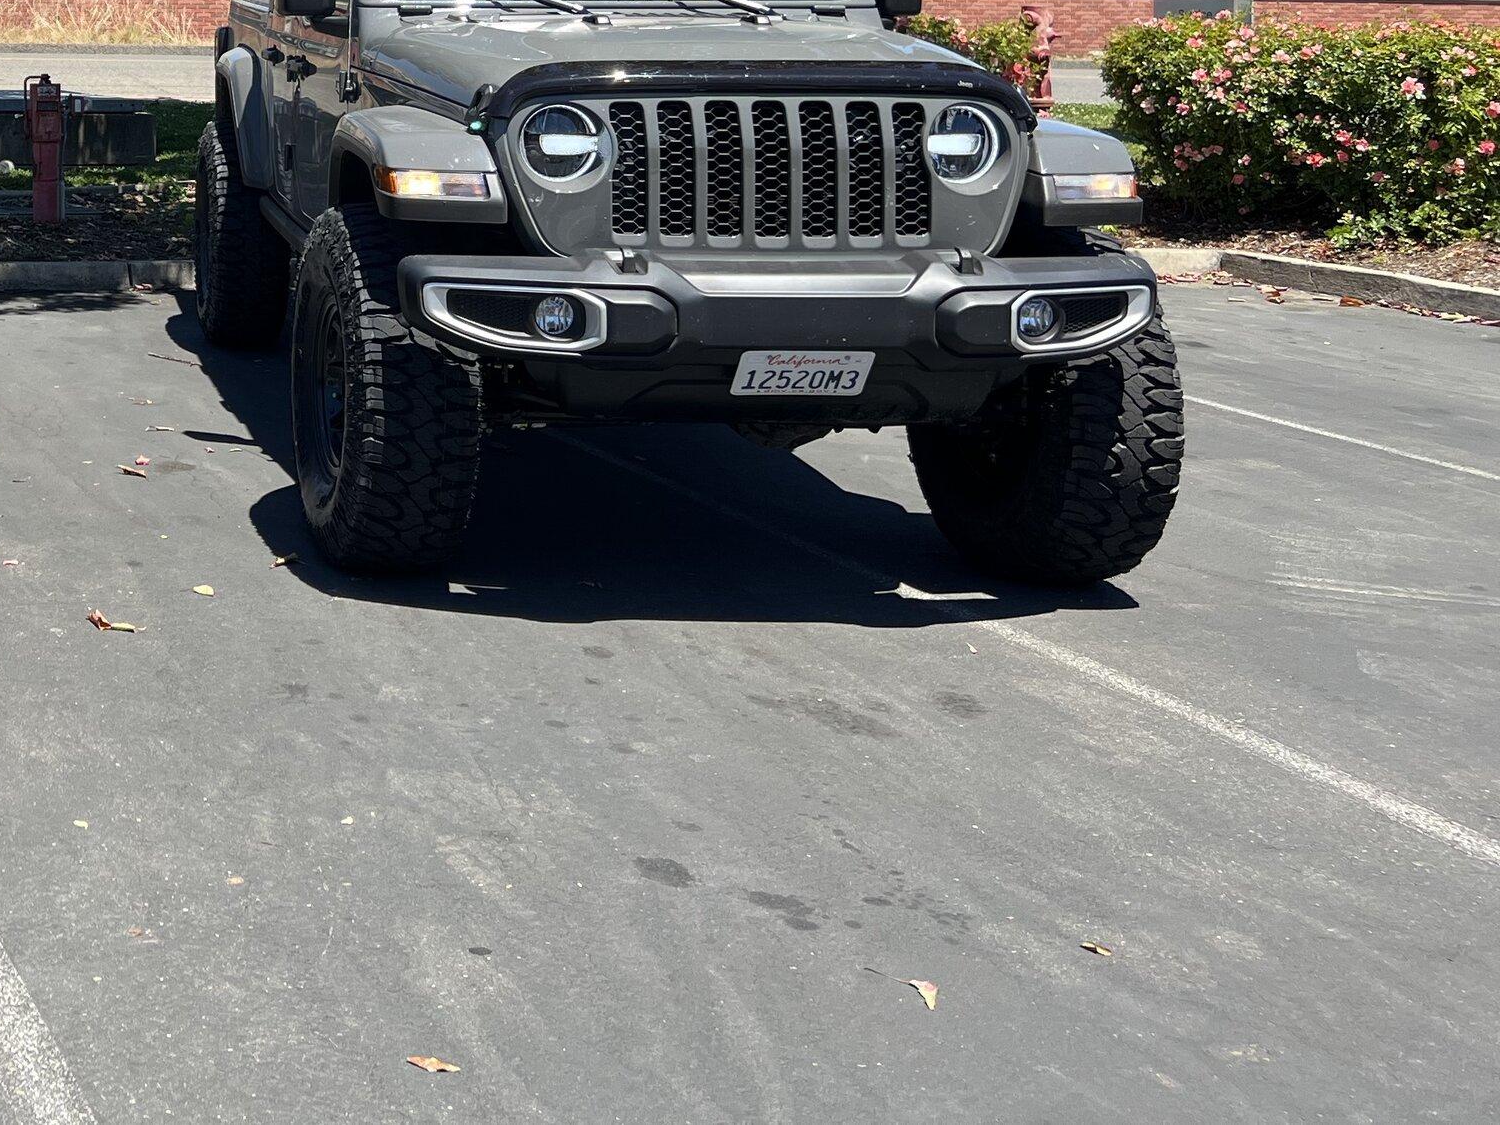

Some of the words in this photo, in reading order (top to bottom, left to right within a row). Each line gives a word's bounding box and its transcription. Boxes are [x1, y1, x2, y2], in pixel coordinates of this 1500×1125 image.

[957, 80, 974, 88] Jeep
[768, 354, 842, 368] California
[741, 370, 860, 390] 12520M3
